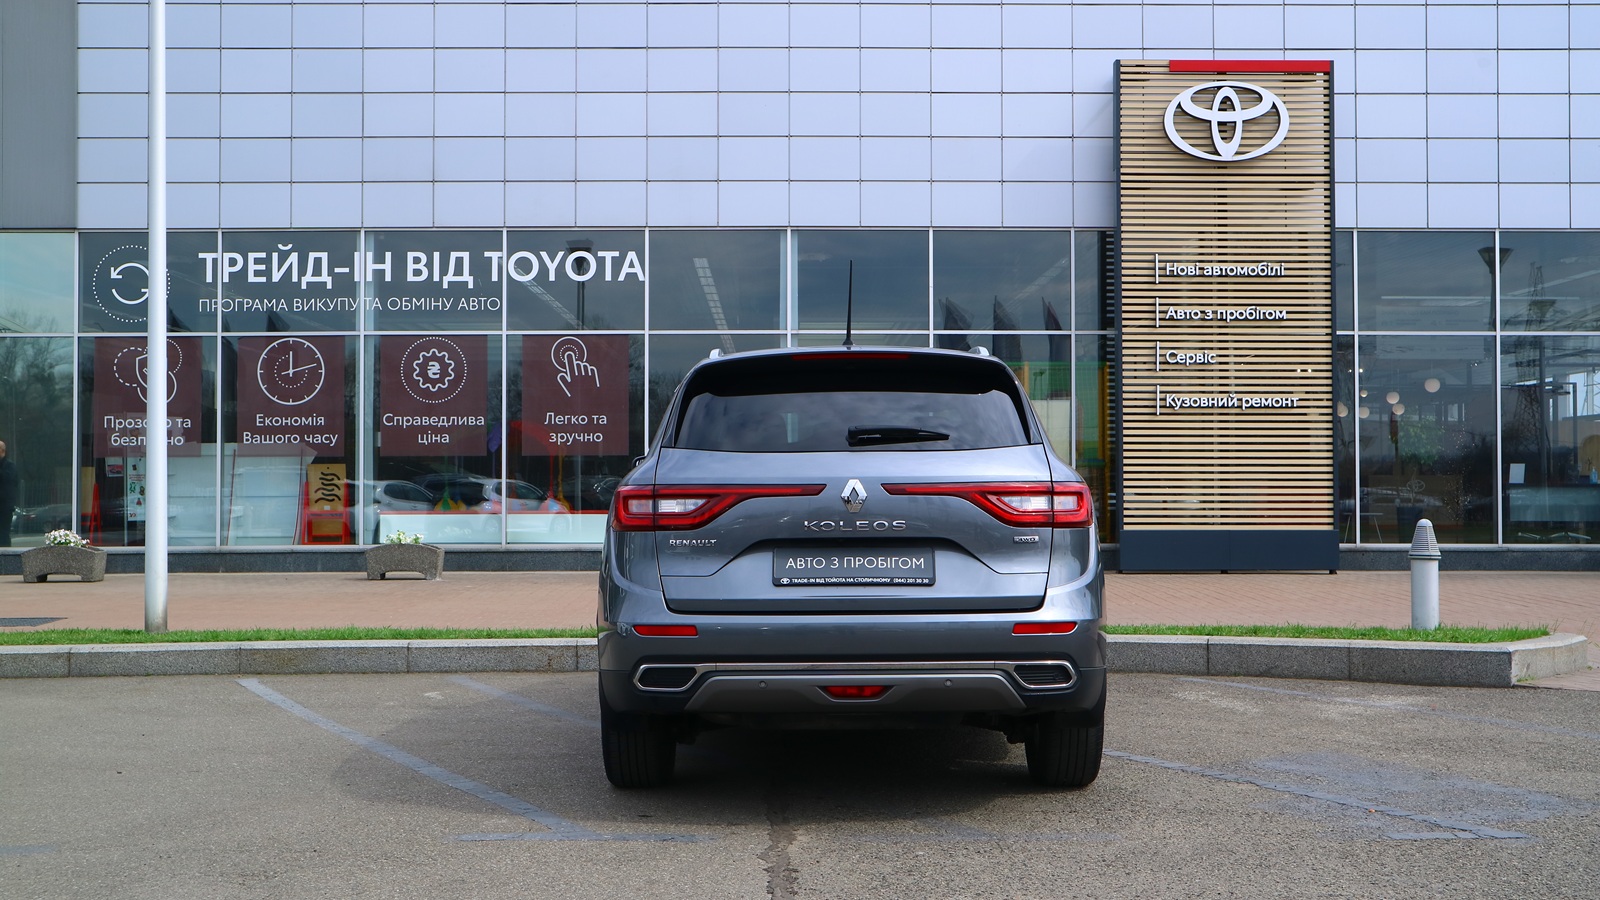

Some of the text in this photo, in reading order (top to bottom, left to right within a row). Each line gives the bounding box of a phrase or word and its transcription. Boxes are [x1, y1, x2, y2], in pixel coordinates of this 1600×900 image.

[198, 243, 646, 289] ТРЕЙД-ІН ВІД TOYOTA
[1165, 262, 1286, 276] Нові автомобілі
[199, 297, 501, 312] ПРОГРАМА ВИКУПУ ТА ОБМІНУ АВТО
[1165, 306, 1287, 323] Авто з пробігом
[1165, 350, 1217, 366] Сервіс
[1165, 393, 1300, 410] Кузовний ремонт
[175, 418, 192, 428] та
[255, 413, 325, 426] Економія
[382, 413, 485, 428] Справедлива
[544, 412, 608, 425] Легко та
[111, 433, 184, 446] безпно
[243, 431, 338, 447] Вашого часу
[418, 431, 450, 445] ціна
[549, 432, 603, 446] зручно
[804, 520, 907, 532] KOLEOS
[669, 539, 717, 547] RENAULT
[785, 557, 925, 569] АВТО З ПРОБІГОМ
